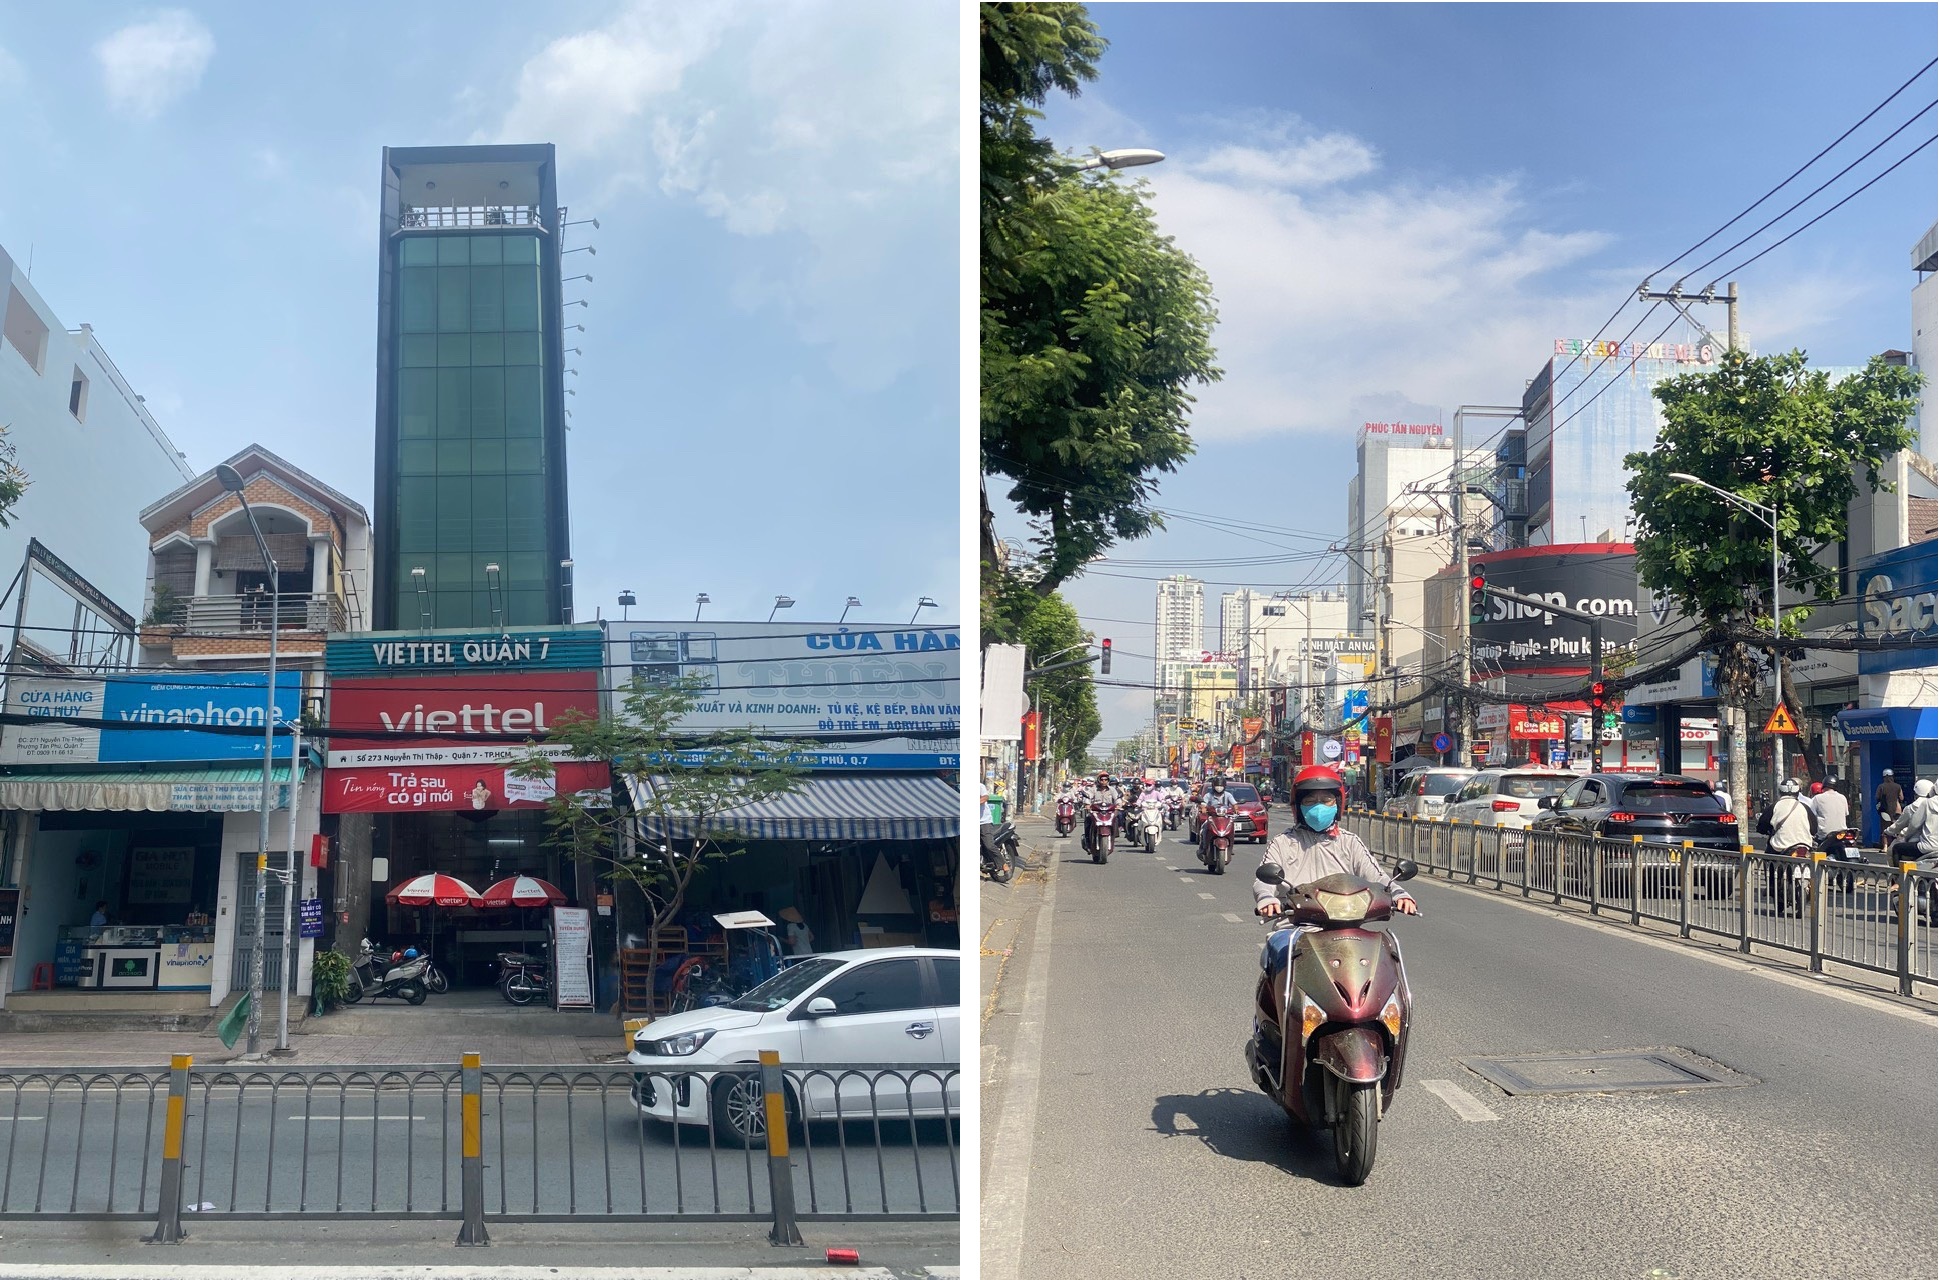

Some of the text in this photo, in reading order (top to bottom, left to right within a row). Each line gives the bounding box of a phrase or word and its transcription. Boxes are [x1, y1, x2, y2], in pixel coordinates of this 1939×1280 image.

[1555, 339, 1643, 358] KARAOKE
[1700, 344, 1712, 360] 6
[1365, 421, 1389, 433] PHÚC
[1409, 423, 1443, 436] NGUYÊN
[806, 628, 883, 651] CỬA
[373, 634, 550, 666] VIETTEL QUẬN 7
[1472, 644, 1502, 662] Laptop
[1509, 638, 1541, 661] Apple
[1550, 636, 1580, 658] Phụ
[21, 689, 93, 703] CỬA HÀNG
[28, 706, 82, 717] GIA HUY
[120, 701, 284, 732] vinaphone
[728, 701, 743, 713] VÀ
[746, 703, 775, 714] KINH
[778, 703, 821, 714] DOANH:
[827, 701, 842, 715] TỦ
[845, 703, 863, 717] KỆ,
[866, 703, 881, 717] KỆ
[885, 702, 909, 716] BẾP,
[911, 703, 935, 715] BÀN
[379, 702, 551, 733] viettel
[1843, 720, 1890, 735] Sacombank
[357, 753, 367, 762] Số
[368, 754, 382, 762] 273
[384, 752, 410, 763] Nguyễn
[412, 753, 424, 762] Thị
[425, 752, 443, 763] Thập
[452, 751, 470, 761] Quận
[473, 751, 477, 759] 7
[821, 754, 848, 766] PHÚ,
[851, 756, 868, 765] Q.7
[939, 756, 956, 765] ĐT:
[340, 777, 386, 797] Tin nóng
[388, 772, 446, 788] Trả sau
[388, 790, 410, 806] có
[412, 790, 427, 806] gì
[429, 788, 453, 803] mới
[166, 957, 202, 967] vinaphone
